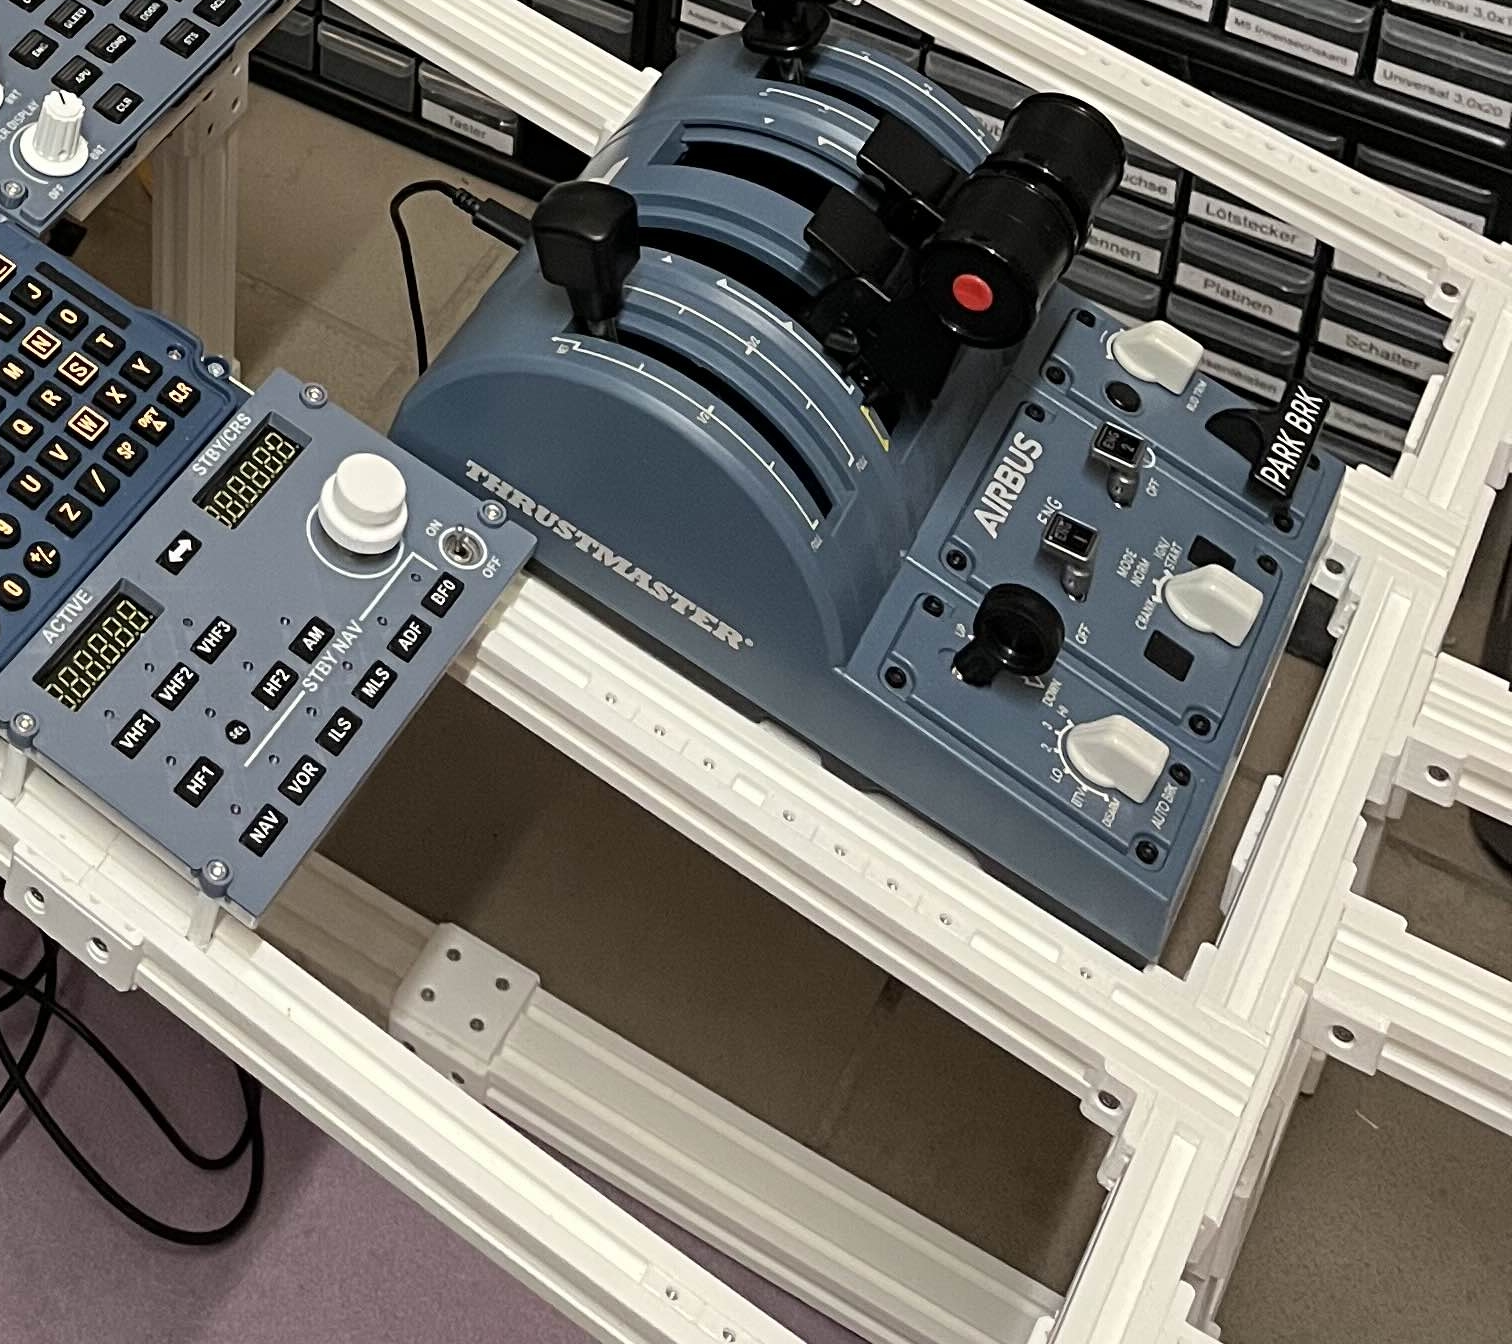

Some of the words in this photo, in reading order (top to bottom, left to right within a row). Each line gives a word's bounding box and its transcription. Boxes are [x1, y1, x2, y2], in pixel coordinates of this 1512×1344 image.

[1382, 68, 1450, 99] Universal
[1205, 202, 1298, 245] Lötstecker
[1203, 277, 1274, 317] Platinen
[1345, 333, 1422, 373] Schalter
[192, 411, 253, 477] STBY/CRS
[1260, 421, 1301, 490] PARK
[1294, 385, 1324, 437] BRK
[973, 431, 1043, 540] AIRBUS
[465, 458, 745, 651] THRUSTMASTER
[1117, 548, 1137, 579] MODE
[1130, 558, 1150, 588] NORM
[41, 587, 95, 645] ACTIVE
[197, 619, 233, 656] VHF3
[397, 621, 424, 652] ADF
[157, 666, 195, 706] VHF2
[261, 669, 291, 698] HF2
[359, 666, 391, 698] MLS
[118, 713, 156, 750] VHF1
[327, 716, 352, 743] ILS
[186, 764, 217, 796] HF1
[286, 762, 320, 796] VOR
[249, 810, 280, 846] NAV
[1151, 800, 1170, 830] AUTO
